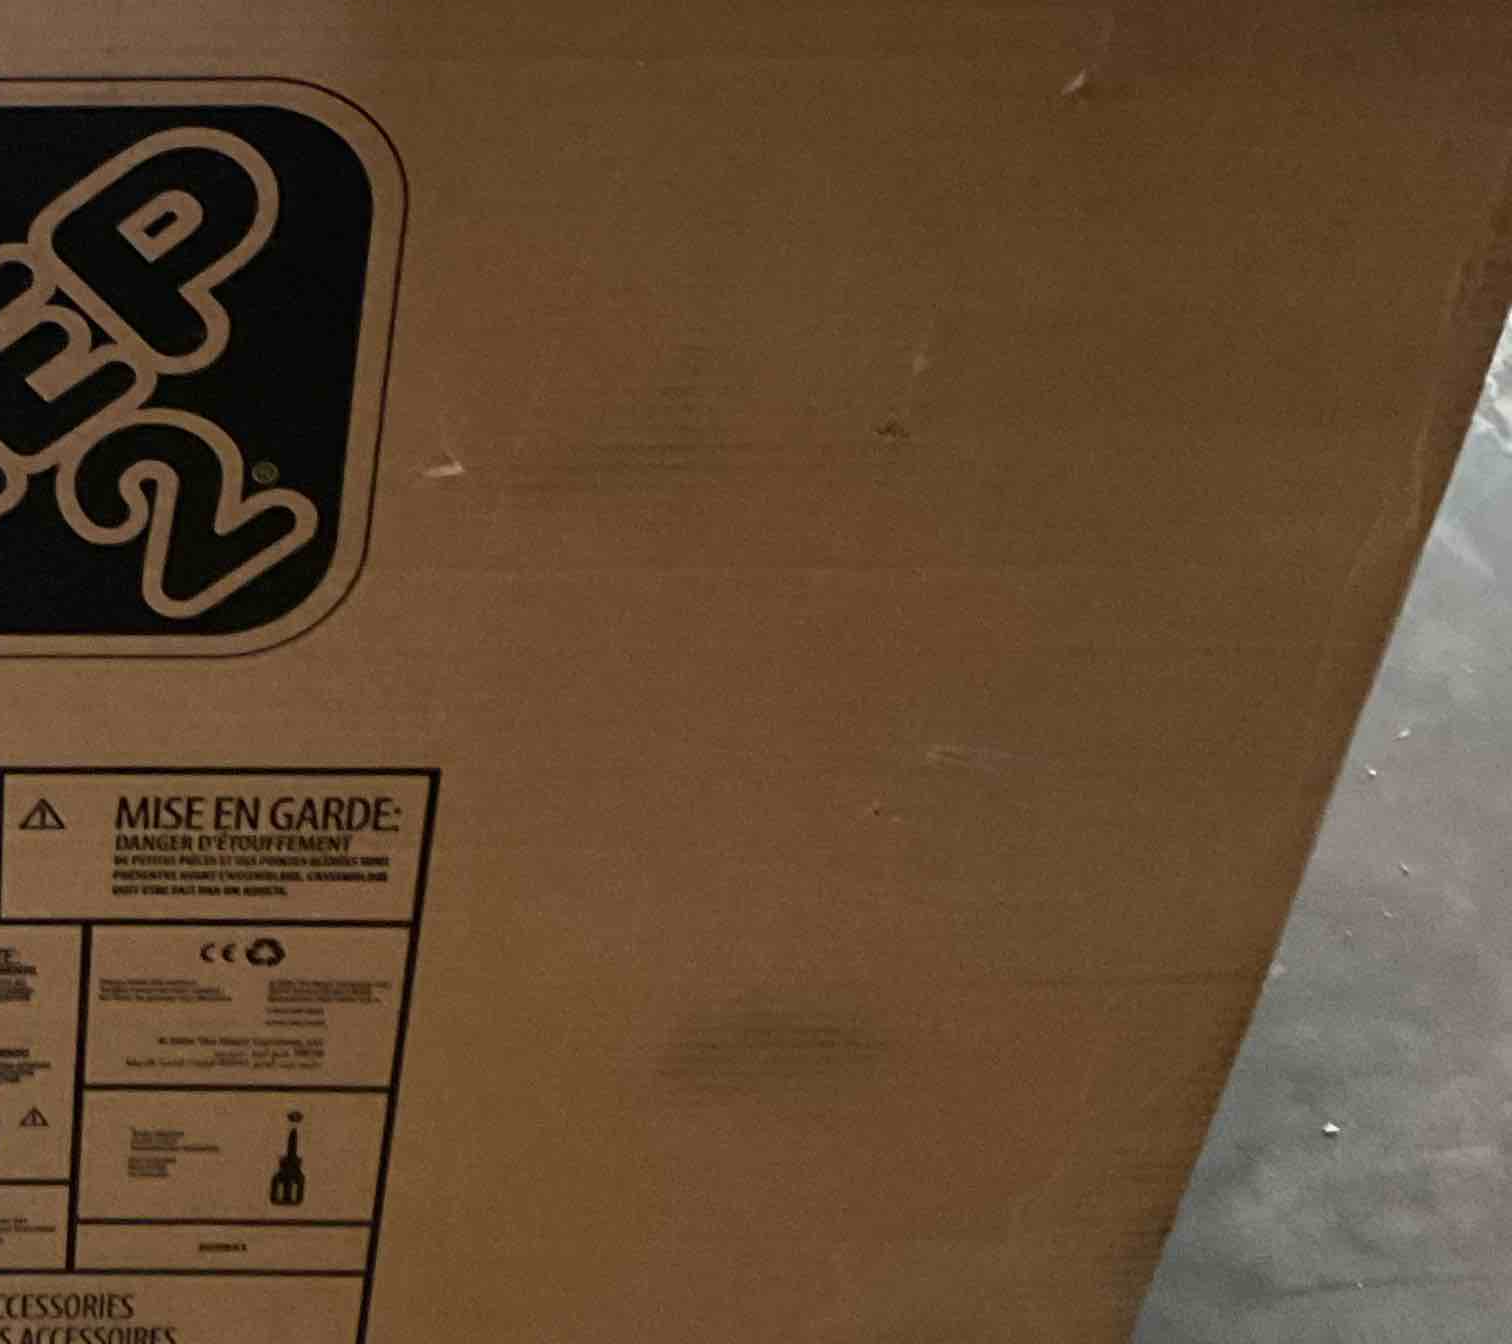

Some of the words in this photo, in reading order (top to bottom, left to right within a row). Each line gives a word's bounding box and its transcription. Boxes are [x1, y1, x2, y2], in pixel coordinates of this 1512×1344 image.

[55, 406, 318, 621] 2
[115, 796, 206, 831] MISE
[213, 796, 260, 831] EN
[270, 796, 403, 833] GARDE:
[115, 834, 188, 853] DANGER
